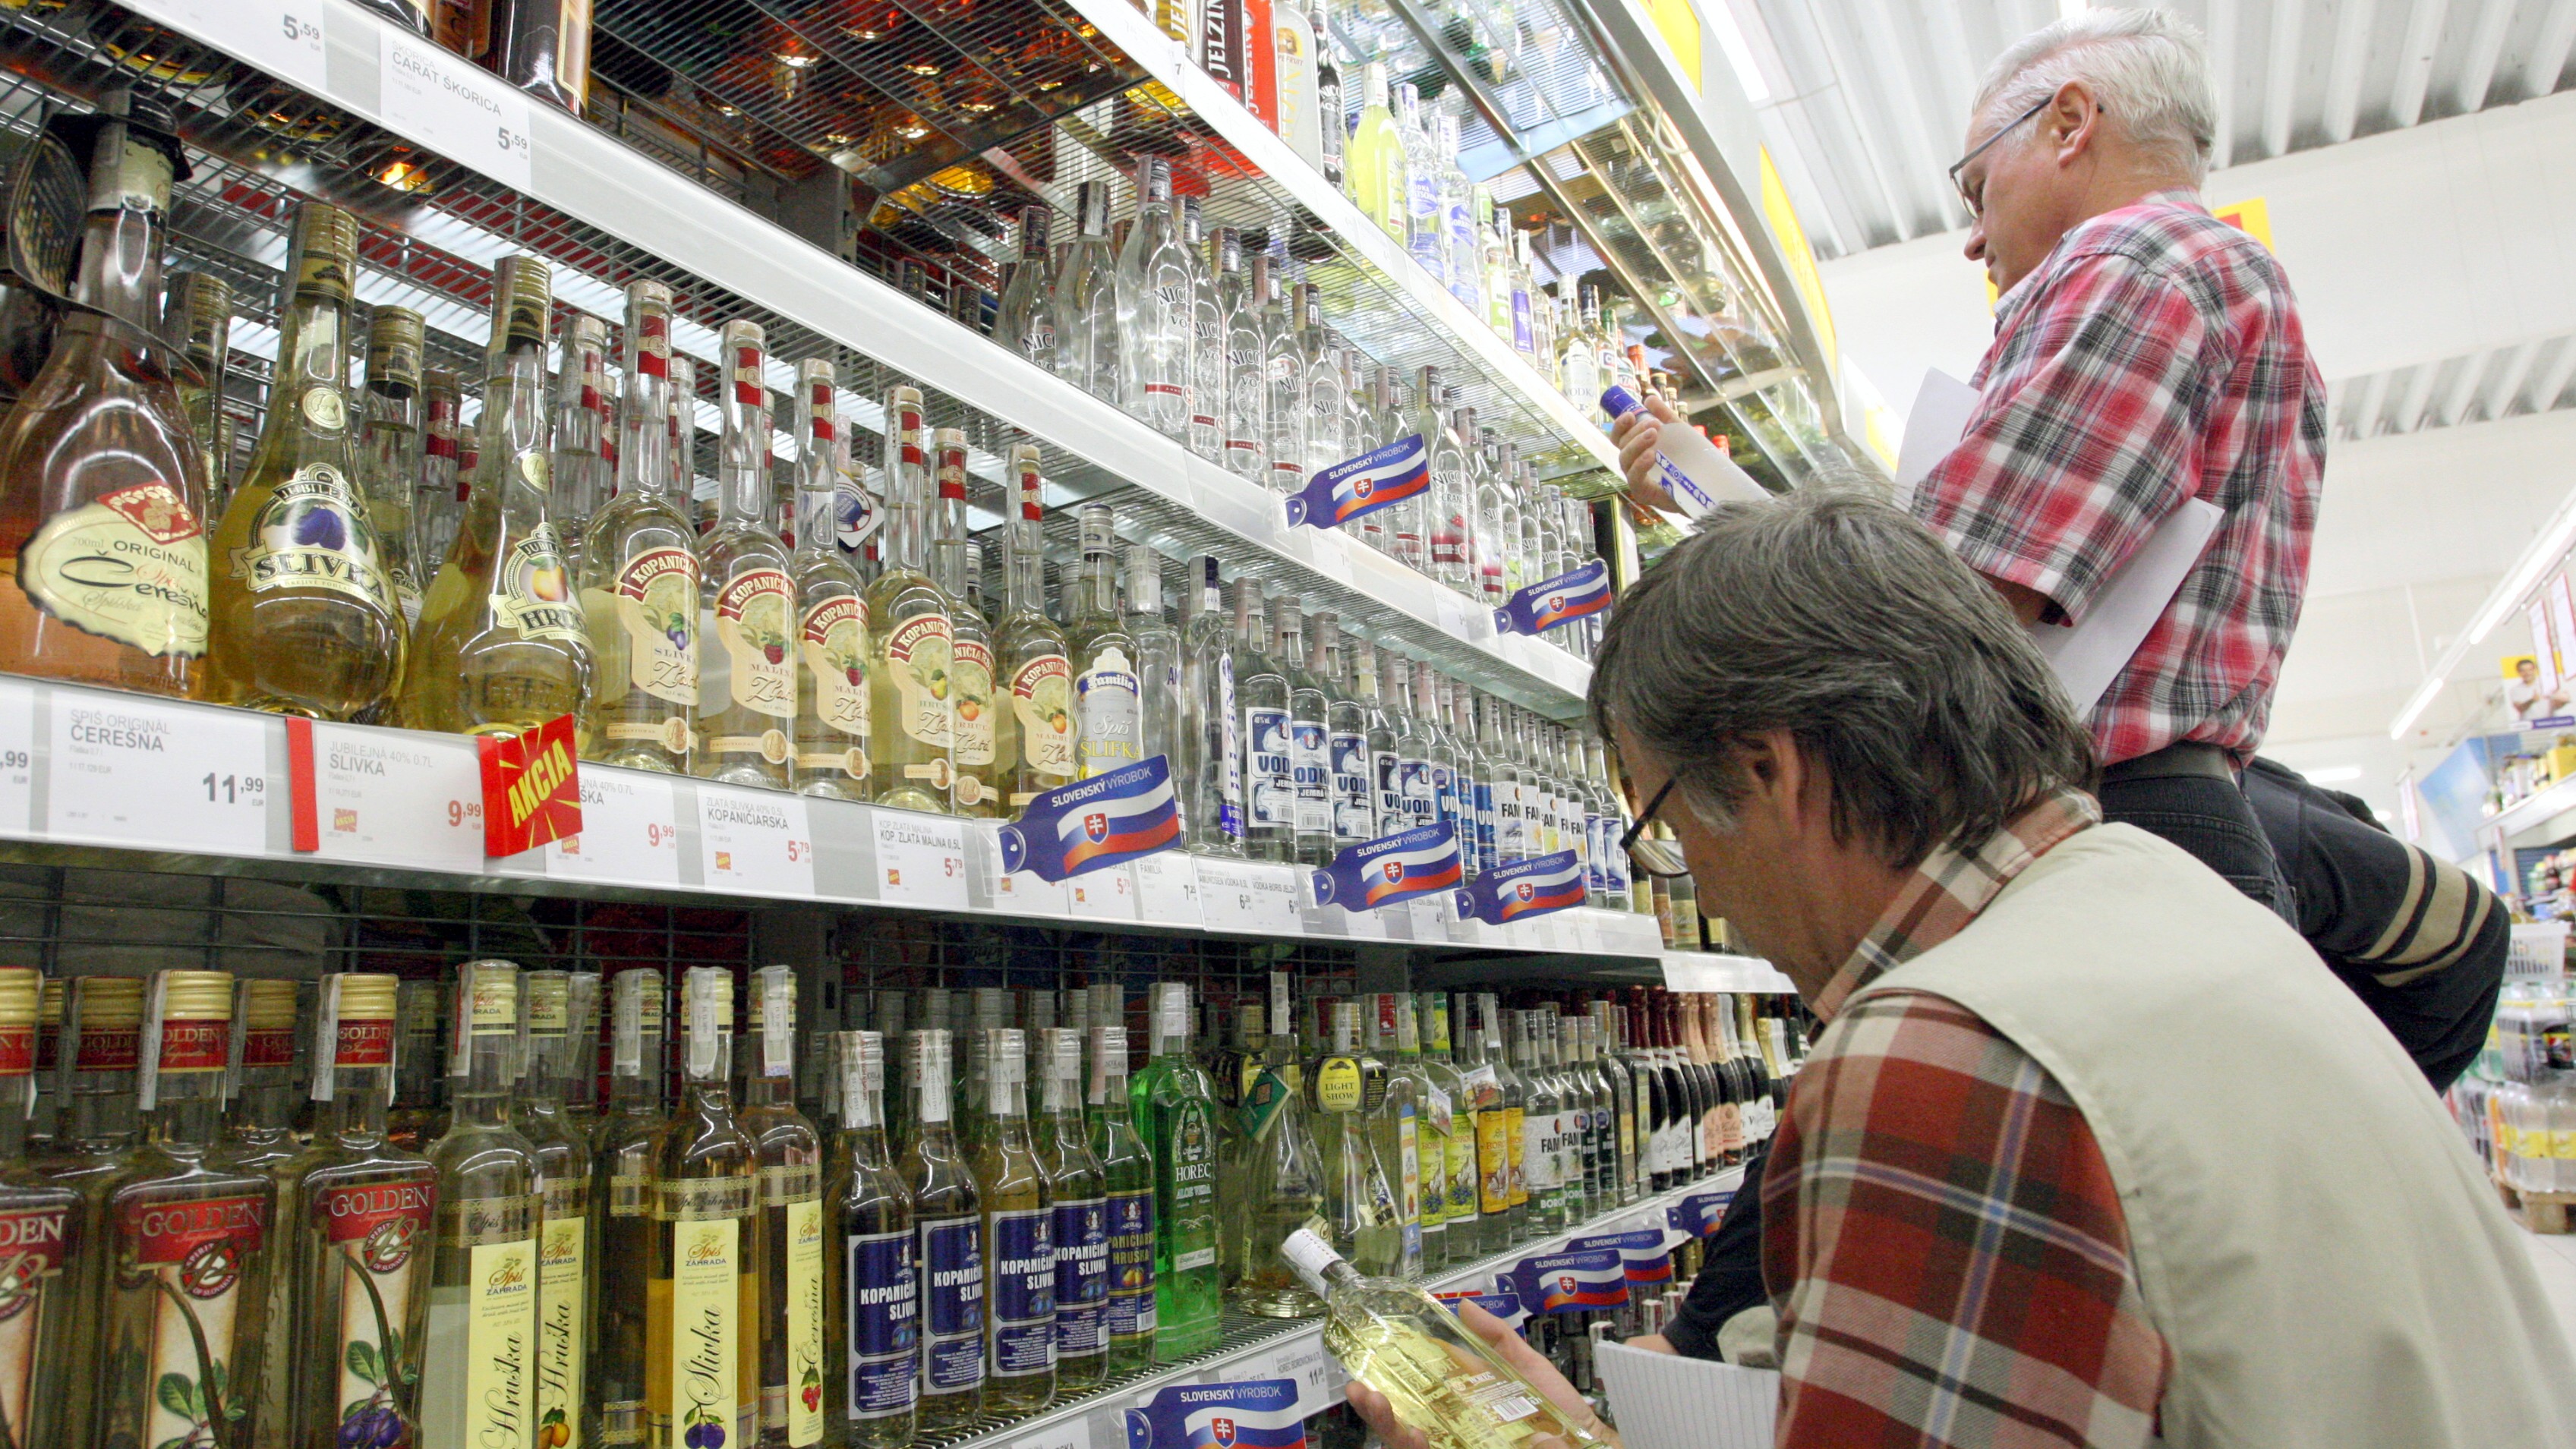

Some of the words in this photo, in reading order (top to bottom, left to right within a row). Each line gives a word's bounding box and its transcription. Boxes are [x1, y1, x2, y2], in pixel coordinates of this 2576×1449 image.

[283, 14, 320, 41] 5,59
[392, 40, 436, 70] ŠKORICA
[393, 51, 440, 84] CARAT
[443, 74, 502, 116] ŠKORICA
[497, 126, 528, 150] 5,59
[1329, 455, 1373, 480] SLOVENSKÝ
[1373, 442, 1411, 461] VÝROBOK
[73, 537, 105, 548] 700ml
[114, 540, 195, 572] ORIGINAL
[254, 552, 389, 610] SLIVKA
[1528, 578, 1564, 597] SLOVENSKÝ
[1563, 569, 1594, 584] VÝROBOK
[71, 708, 103, 723] SPIŠ
[1093, 714, 1130, 739] Spiš
[329, 741, 387, 760] JUBILEJNÁ
[389, 750, 411, 765] 40%
[1080, 737, 1141, 759] ŠLIFKA
[329, 754, 385, 777] SLIVKA
[202, 771, 264, 804] 11,99
[507, 738, 574, 829] AKCIA
[600, 780, 616, 793] 40%
[1052, 780, 1106, 808] SLOVENSKÝ
[1106, 766, 1152, 791] VÝROBOK
[448, 800, 482, 827] 9,99
[707, 808, 790, 830] KOPANIČIARSKA
[648, 823, 675, 848] 9,99
[922, 833, 947, 848] MALINA
[1357, 835, 1402, 858] SLOVENSKÝ
[1402, 827, 1440, 846] VÝROBOK
[787, 839, 810, 862] 5,79
[944, 857, 963, 877] 5,79
[1140, 863, 1163, 874] FAMILIA
[1493, 863, 1533, 880] SLOVENSKÝ
[1533, 855, 1566, 870] VÝROBOK
[1199, 875, 1224, 886] AMUNDSEN
[1252, 880, 1269, 890] VODKA
[162, 1027, 219, 1043] OLDEN
[1325, 1081, 1354, 1091] LIGHT
[1325, 1091, 1355, 1101] SHOW
[1175, 1162, 1212, 1183] HOREC
[331, 1185, 432, 1217] GOLDEN
[0, 1215, 65, 1247] DEN
[142, 1202, 265, 1238] GOLDEN
[367, 1222, 392, 1245] SPIRIT
[1583, 1236, 1622, 1249] SLOVENSKÝ
[542, 1241, 574, 1258] Spiš
[688, 1243, 727, 1260] Spiš
[1113, 1246, 1150, 1265] HRUŠKA
[686, 1257, 727, 1267] ZÁHRADA
[1534, 1257, 1575, 1269] SLOVENSKÝ
[1575, 1254, 1609, 1265] VÝROBOK
[486, 1283, 528, 1296] ZÁHRADA
[490, 1267, 525, 1289] Spiš
[680, 1303, 730, 1407] Slivka
[1180, 1388, 1235, 1403] SLOVENSKÝ
[1235, 1385, 1282, 1399] VÝROBOK
